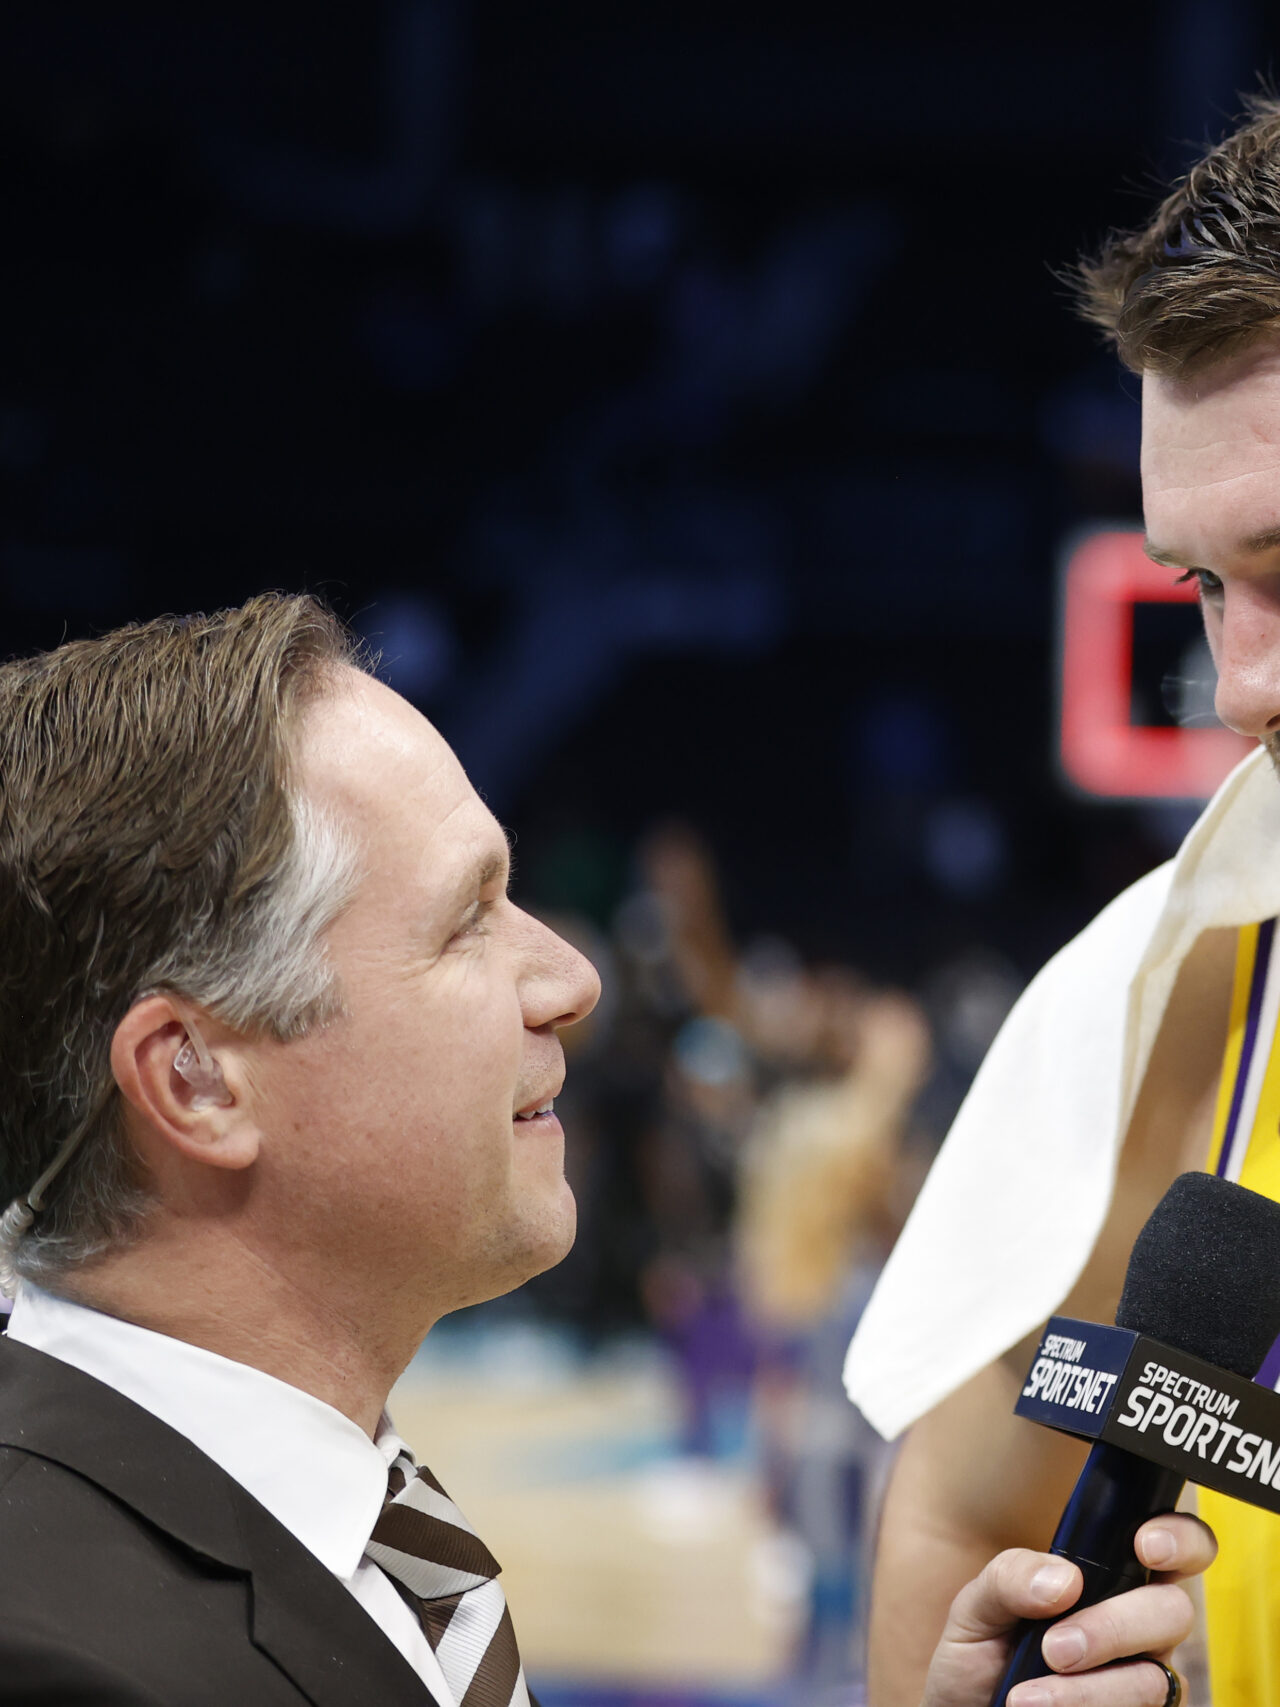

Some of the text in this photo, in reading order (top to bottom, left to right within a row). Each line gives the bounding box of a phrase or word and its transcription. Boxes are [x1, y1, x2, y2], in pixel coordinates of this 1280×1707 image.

[1041, 1334, 1087, 1363] SPECTRUM
[1022, 1357, 1118, 1415] SPORTSNET
[1138, 1361, 1240, 1420] SPECTRUM
